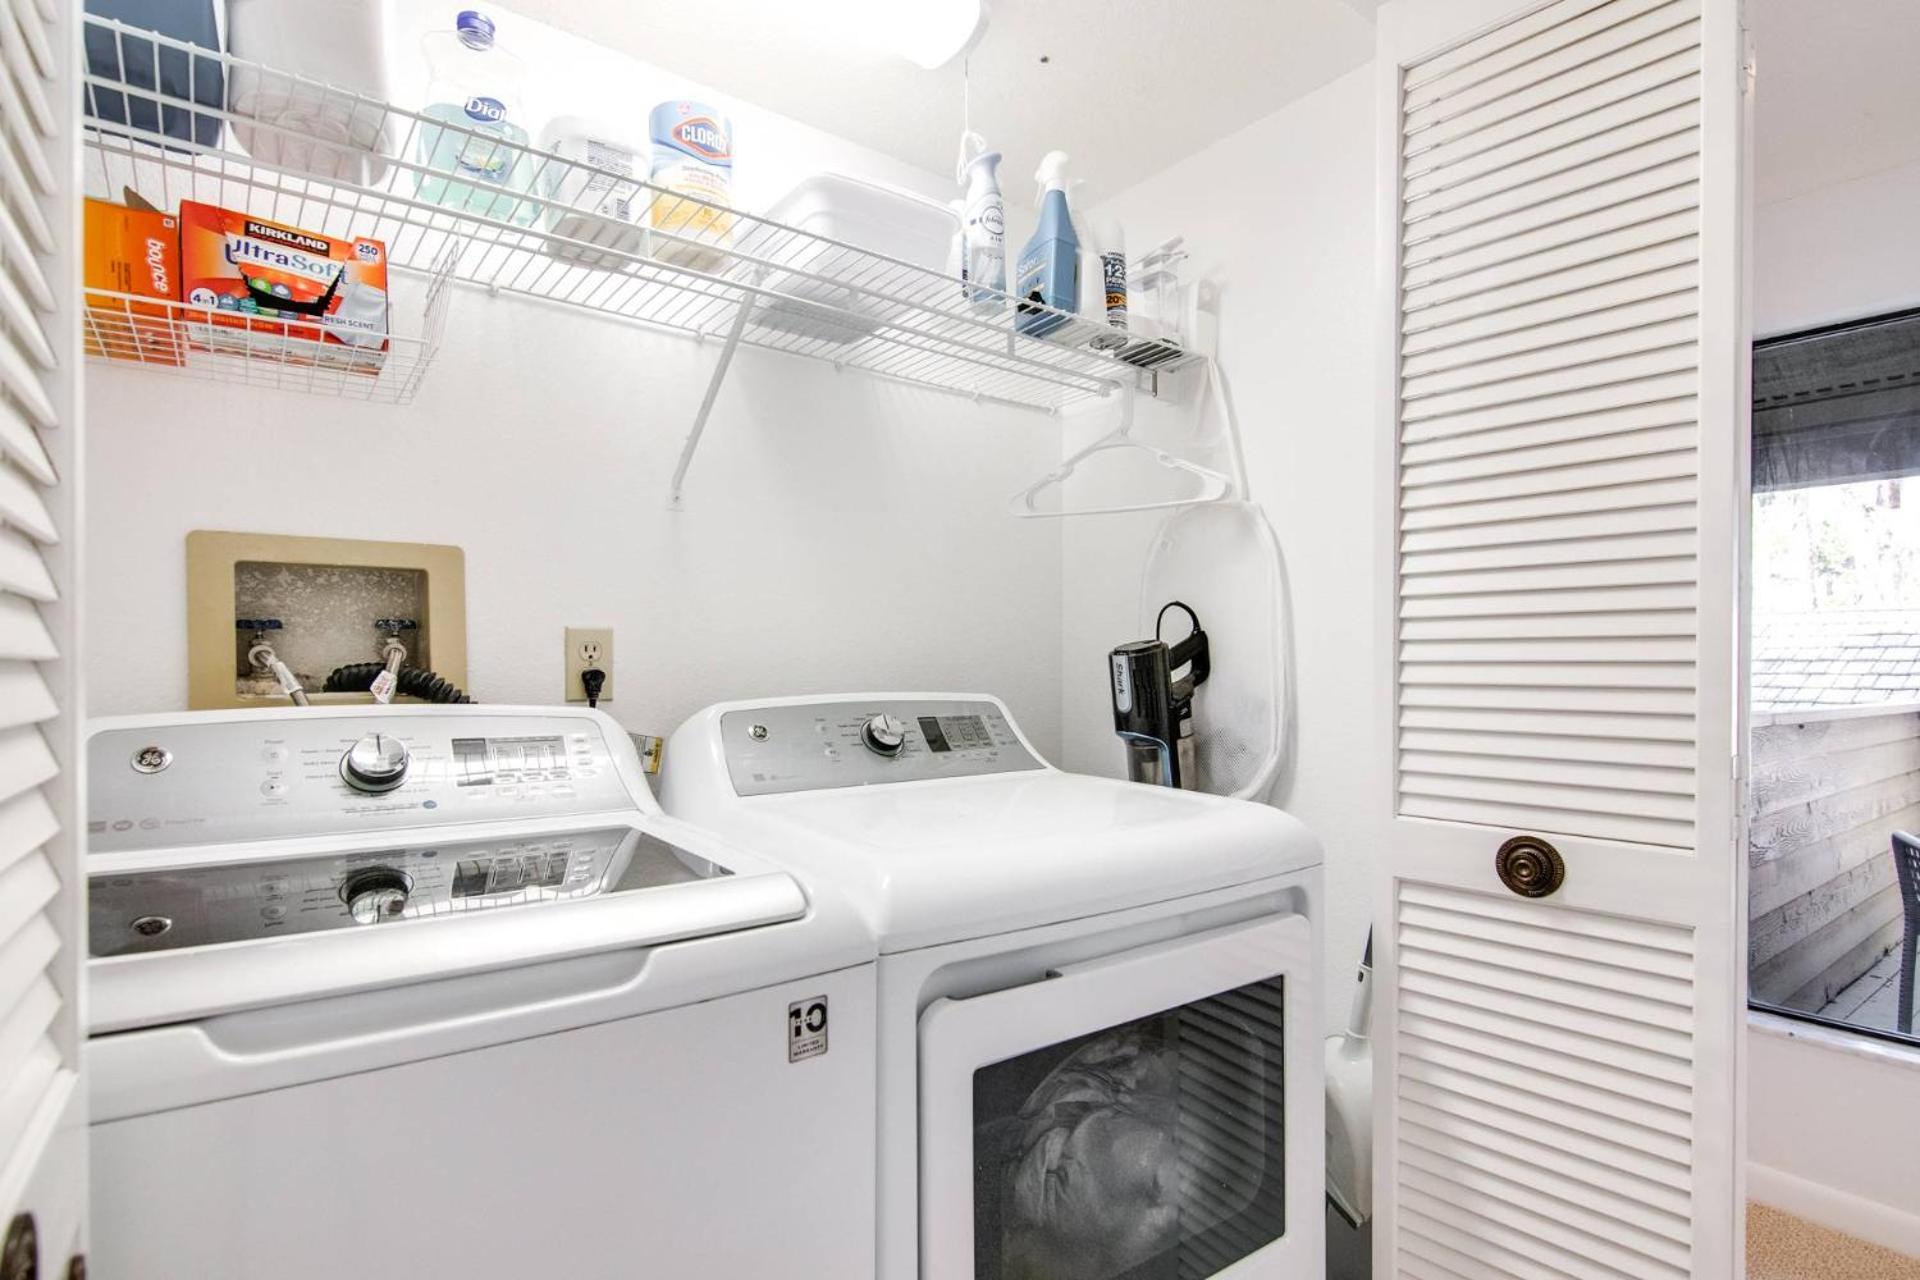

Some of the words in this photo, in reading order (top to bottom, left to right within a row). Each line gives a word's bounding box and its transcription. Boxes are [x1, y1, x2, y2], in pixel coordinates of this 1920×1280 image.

[466, 97, 505, 121] Dial
[248, 222, 328, 251] KIRKLAND
[358, 243, 378, 256] 250
[146, 238, 169, 293] bounce
[193, 294, 201, 303] 4
[348, 319, 376, 330] SCENT
[1115, 662, 1126, 695] Shark
[790, 1003, 827, 1037] 10
